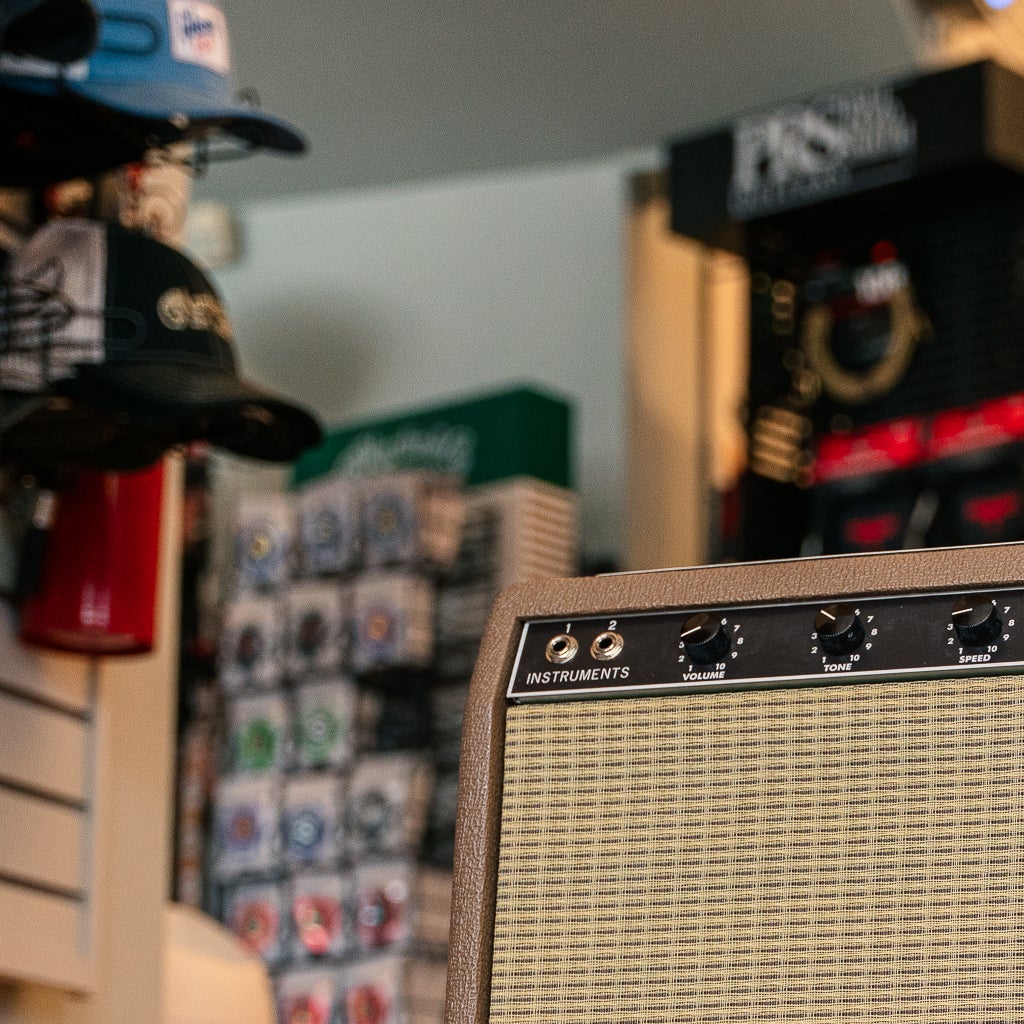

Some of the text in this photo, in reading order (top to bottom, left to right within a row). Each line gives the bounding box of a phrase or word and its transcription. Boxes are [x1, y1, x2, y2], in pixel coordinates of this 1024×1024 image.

[1003, 606, 1011, 614] 7
[721, 617, 728, 626] 6
[867, 615, 874, 623] 7
[1008, 619, 1015, 627] 8
[565, 619, 618, 634] 1 2
[733, 624, 741, 632] 7
[946, 623, 954, 631] 3
[811, 632, 818, 640] 3
[870, 628, 878, 636] 8
[736, 637, 744, 645] 8
[947, 637, 954, 645] 2
[1002, 634, 1010, 642] 9
[678, 641, 685, 649] 3
[865, 642, 872, 650] 9
[987, 645, 998, 653] 10
[810, 646, 818, 654] 2
[958, 647, 964, 655] 1
[678, 655, 685, 663] 2
[731, 651, 738, 659] 9
[849, 654, 860, 662] 10
[958, 654, 991, 664] SPEED
[822, 656, 827, 664] 1
[688, 664, 693, 672] 1
[715, 662, 726, 670] 10
[823, 663, 853, 672] TONE
[525, 666, 630, 685] INSTRUMENTS
[682, 671, 726, 681] VOLUME
